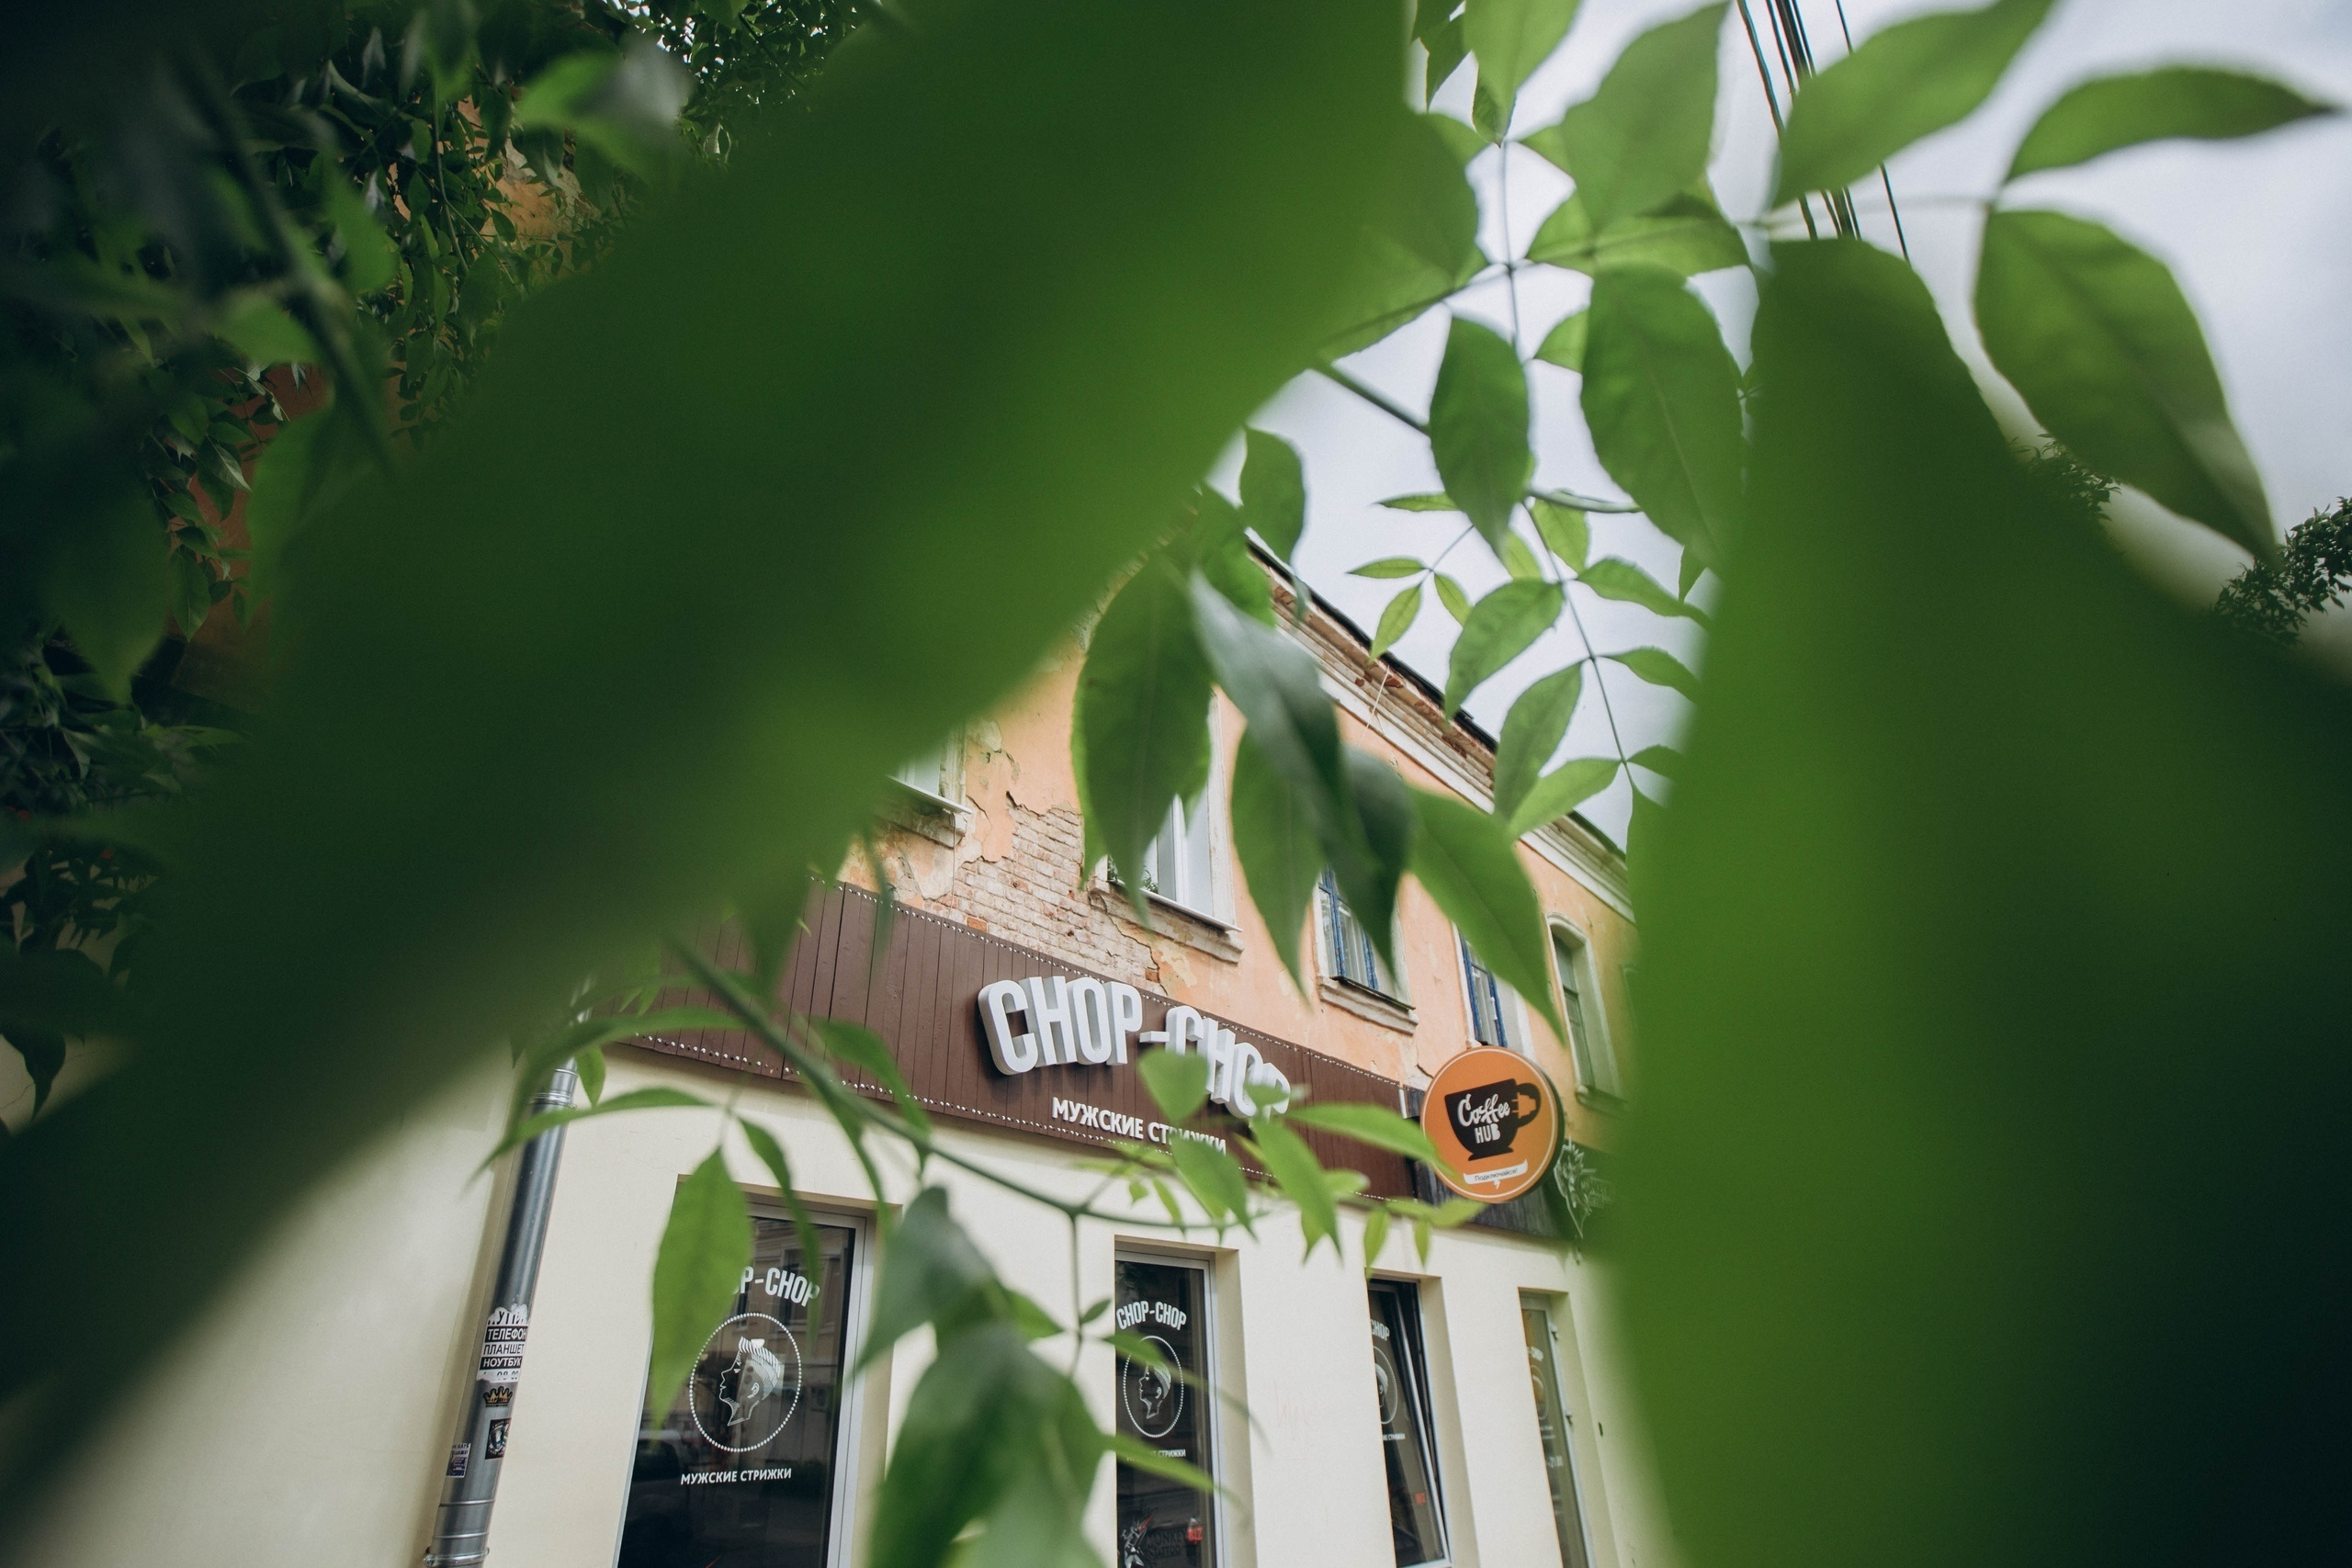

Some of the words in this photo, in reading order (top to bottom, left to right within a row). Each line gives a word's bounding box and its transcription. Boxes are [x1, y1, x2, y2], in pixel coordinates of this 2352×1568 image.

[1052, 1097, 1144, 1140] МУЖСКИЕ
[1457, 1093, 1510, 1127] Coffee
[1475, 1122, 1501, 1145] HUB
[1116, 1301, 1187, 1331] CHOP-CHOP
[483, 1344, 525, 1355] ПЛАНШЕТ
[483, 1358, 522, 1368] НОУТБУК
[681, 1471, 737, 1485] МУЖСКИЕ
[741, 1468, 792, 1483] СТРИЖКИ
